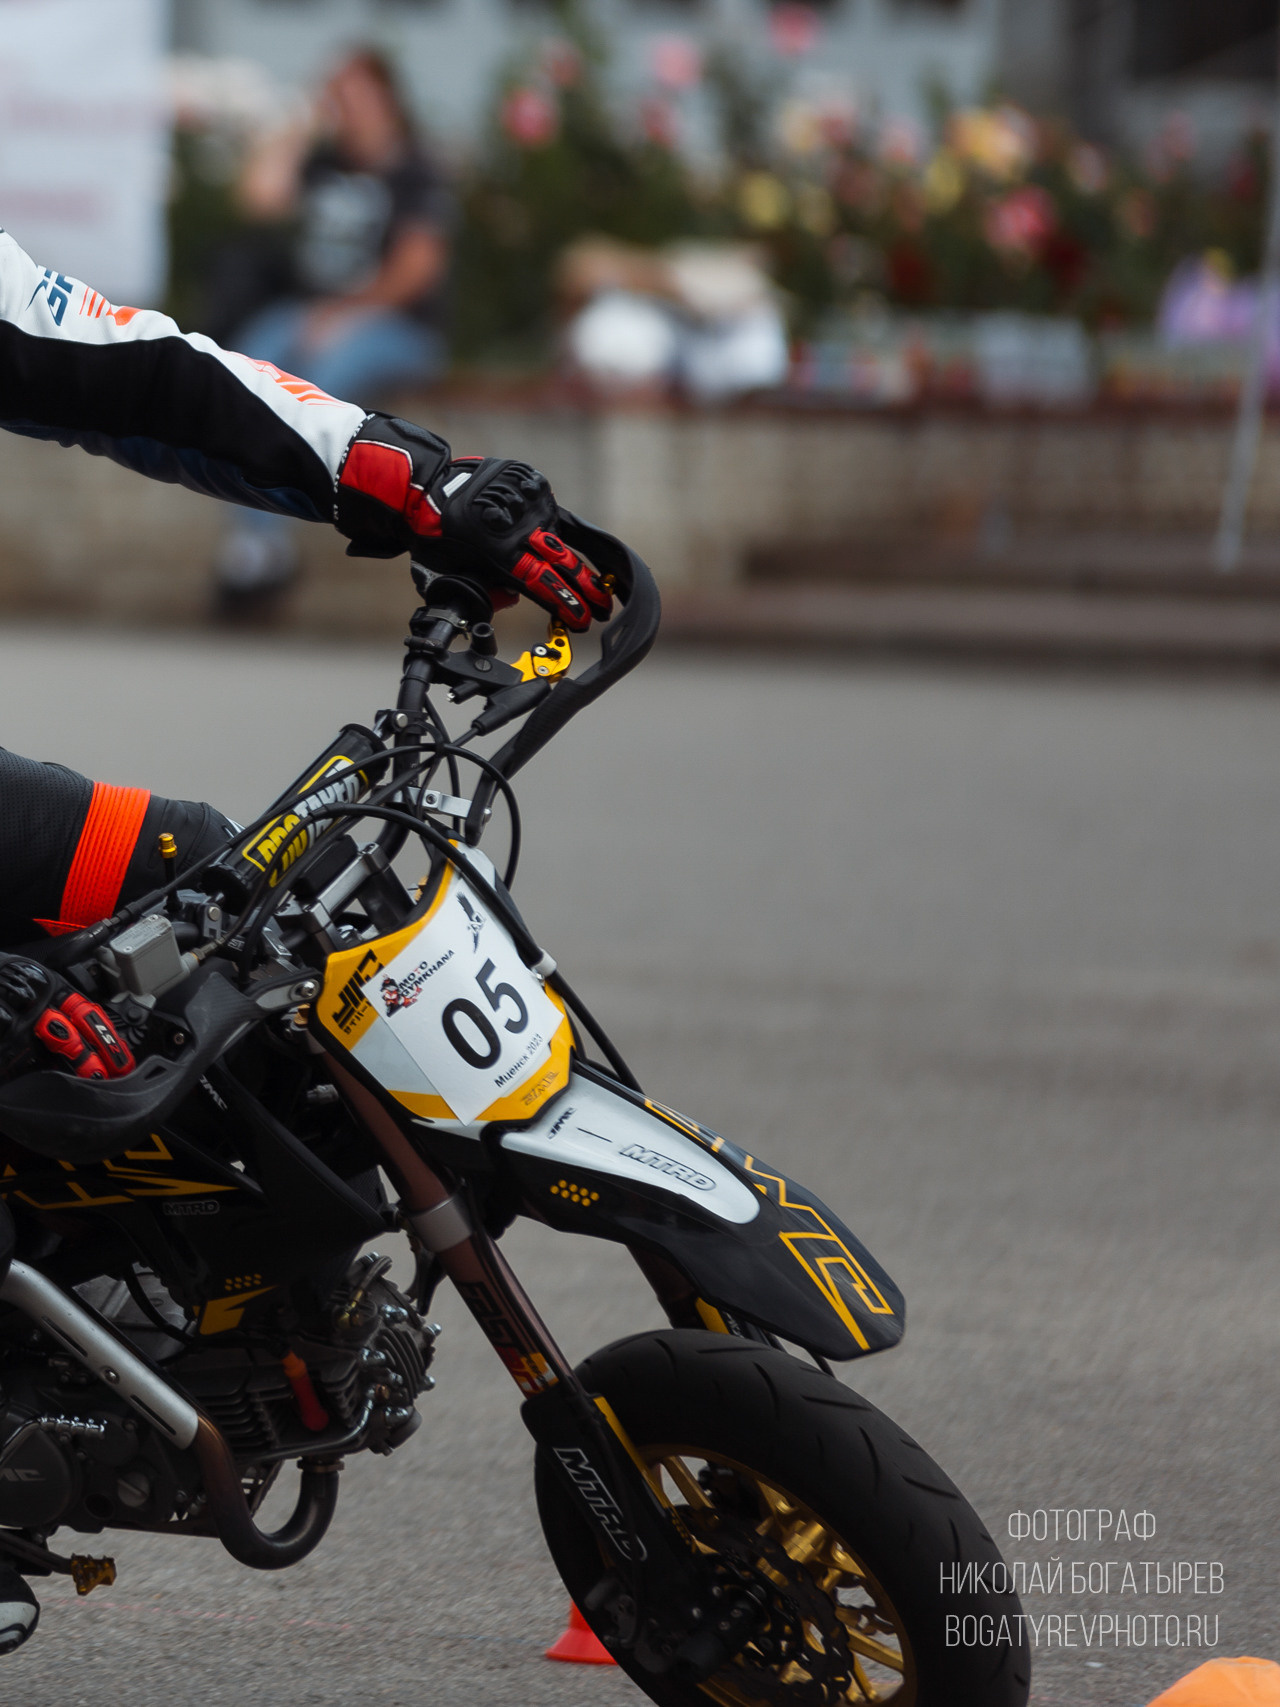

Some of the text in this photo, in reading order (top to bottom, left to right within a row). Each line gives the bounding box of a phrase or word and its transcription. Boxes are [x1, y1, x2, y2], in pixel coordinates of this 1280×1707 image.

[398, 960, 429, 990] MOTO
[401, 949, 455, 997] GYMKHANA
[441, 957, 529, 1070] 05
[94, 1024, 121, 1054] LS2
[494, 1054, 530, 1088] Мценск
[527, 1032, 544, 1057] 2023
[618, 1143, 718, 1192] MTRD
[162, 1199, 220, 1216] MTRD
